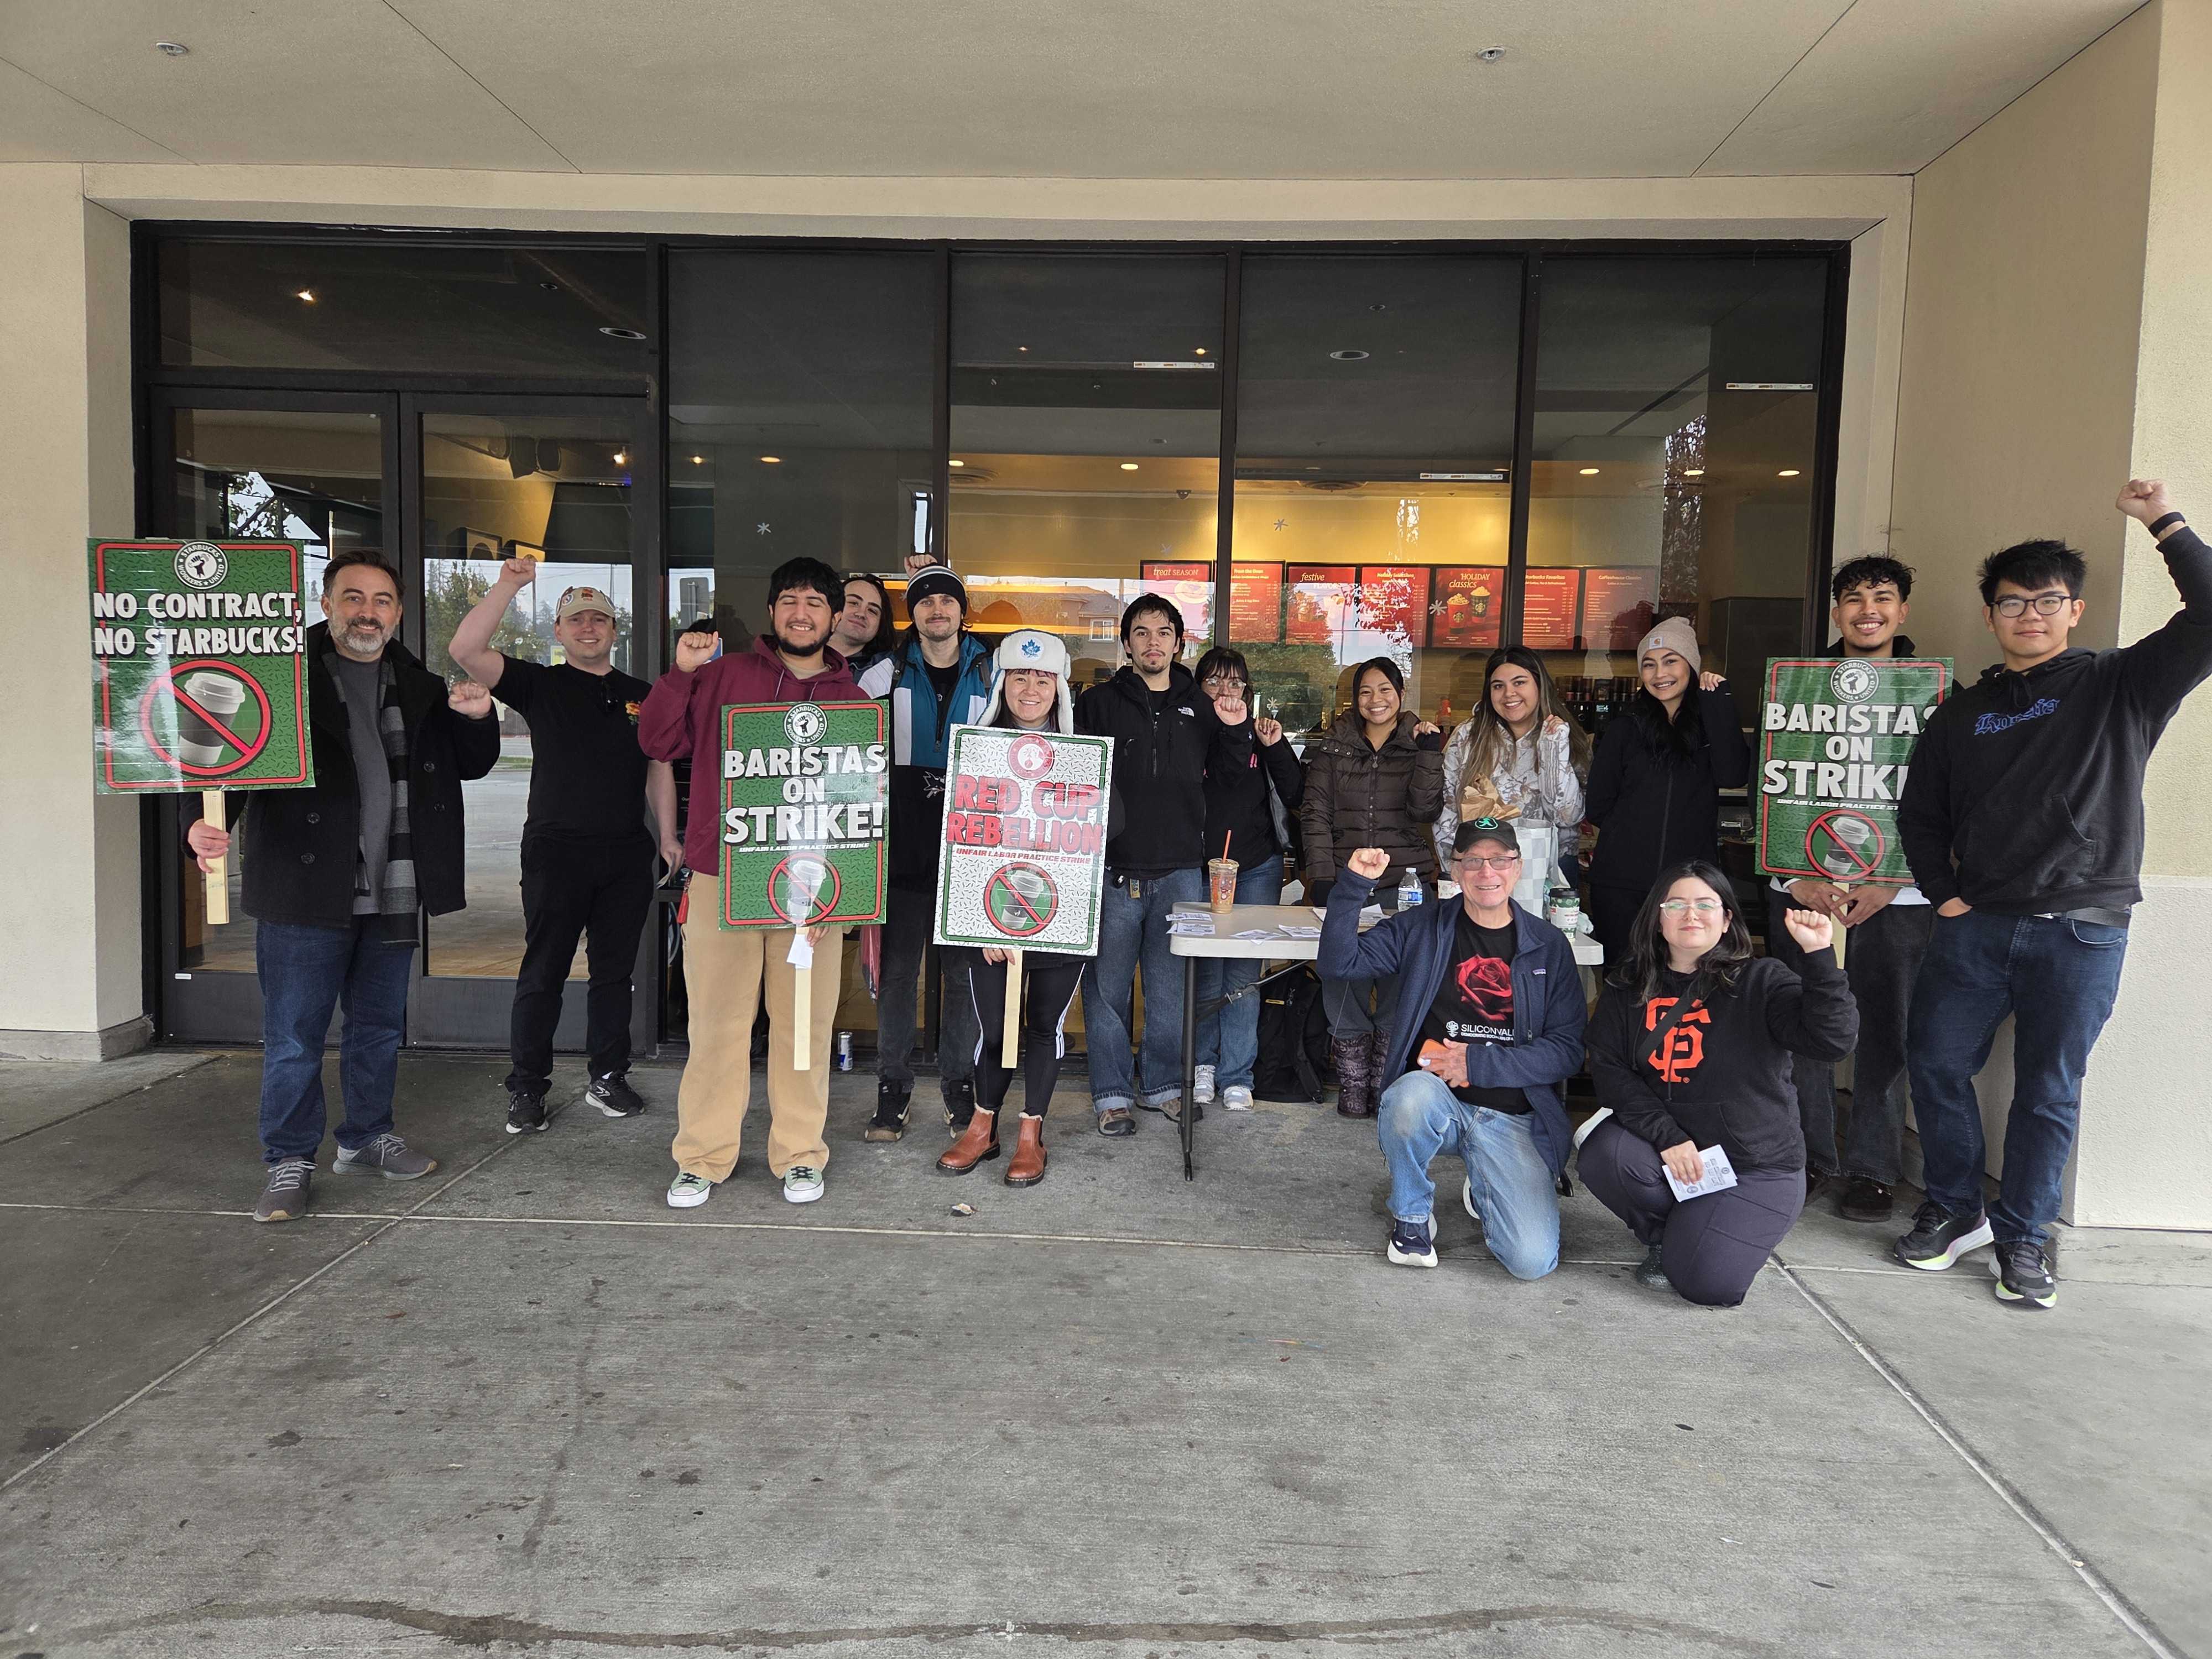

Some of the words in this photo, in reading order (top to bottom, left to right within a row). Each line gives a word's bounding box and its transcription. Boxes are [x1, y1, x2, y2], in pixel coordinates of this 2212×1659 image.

[181, 545, 220, 557] STARBUCKS
[178, 565, 202, 586] WORKERS
[208, 564, 225, 583] UNITED
[1300, 572, 1325, 582] festive
[1449, 580, 1477, 588] classics
[93, 593, 137, 618] NO
[147, 592, 302, 623] CONTRACT,
[94, 628, 135, 655] NO
[145, 627, 304, 655] STARBUCKS!
[1838, 662, 1872, 674] STARBUCKS
[1833, 681, 1854, 700] WORKERS
[1860, 681, 1875, 698] UNITED
[790, 706, 822, 719] STARBUCKS
[787, 724, 806, 743] WORKERS
[811, 723, 825, 740] UNITED
[1825, 735, 1873, 761] ON
[724, 745, 886, 778] BARISTAS
[782, 778, 825, 803] ON
[954, 775, 1021, 813] RED
[1031, 781, 1101, 821] CUP
[1839, 802, 1886, 811] PRACTICE
[723, 802, 883, 843] STRIKE!
[946, 811, 1103, 855] REBELLION
[956, 848, 987, 857] UNFAIR
[1017, 853, 1059, 862] PRACTICE
